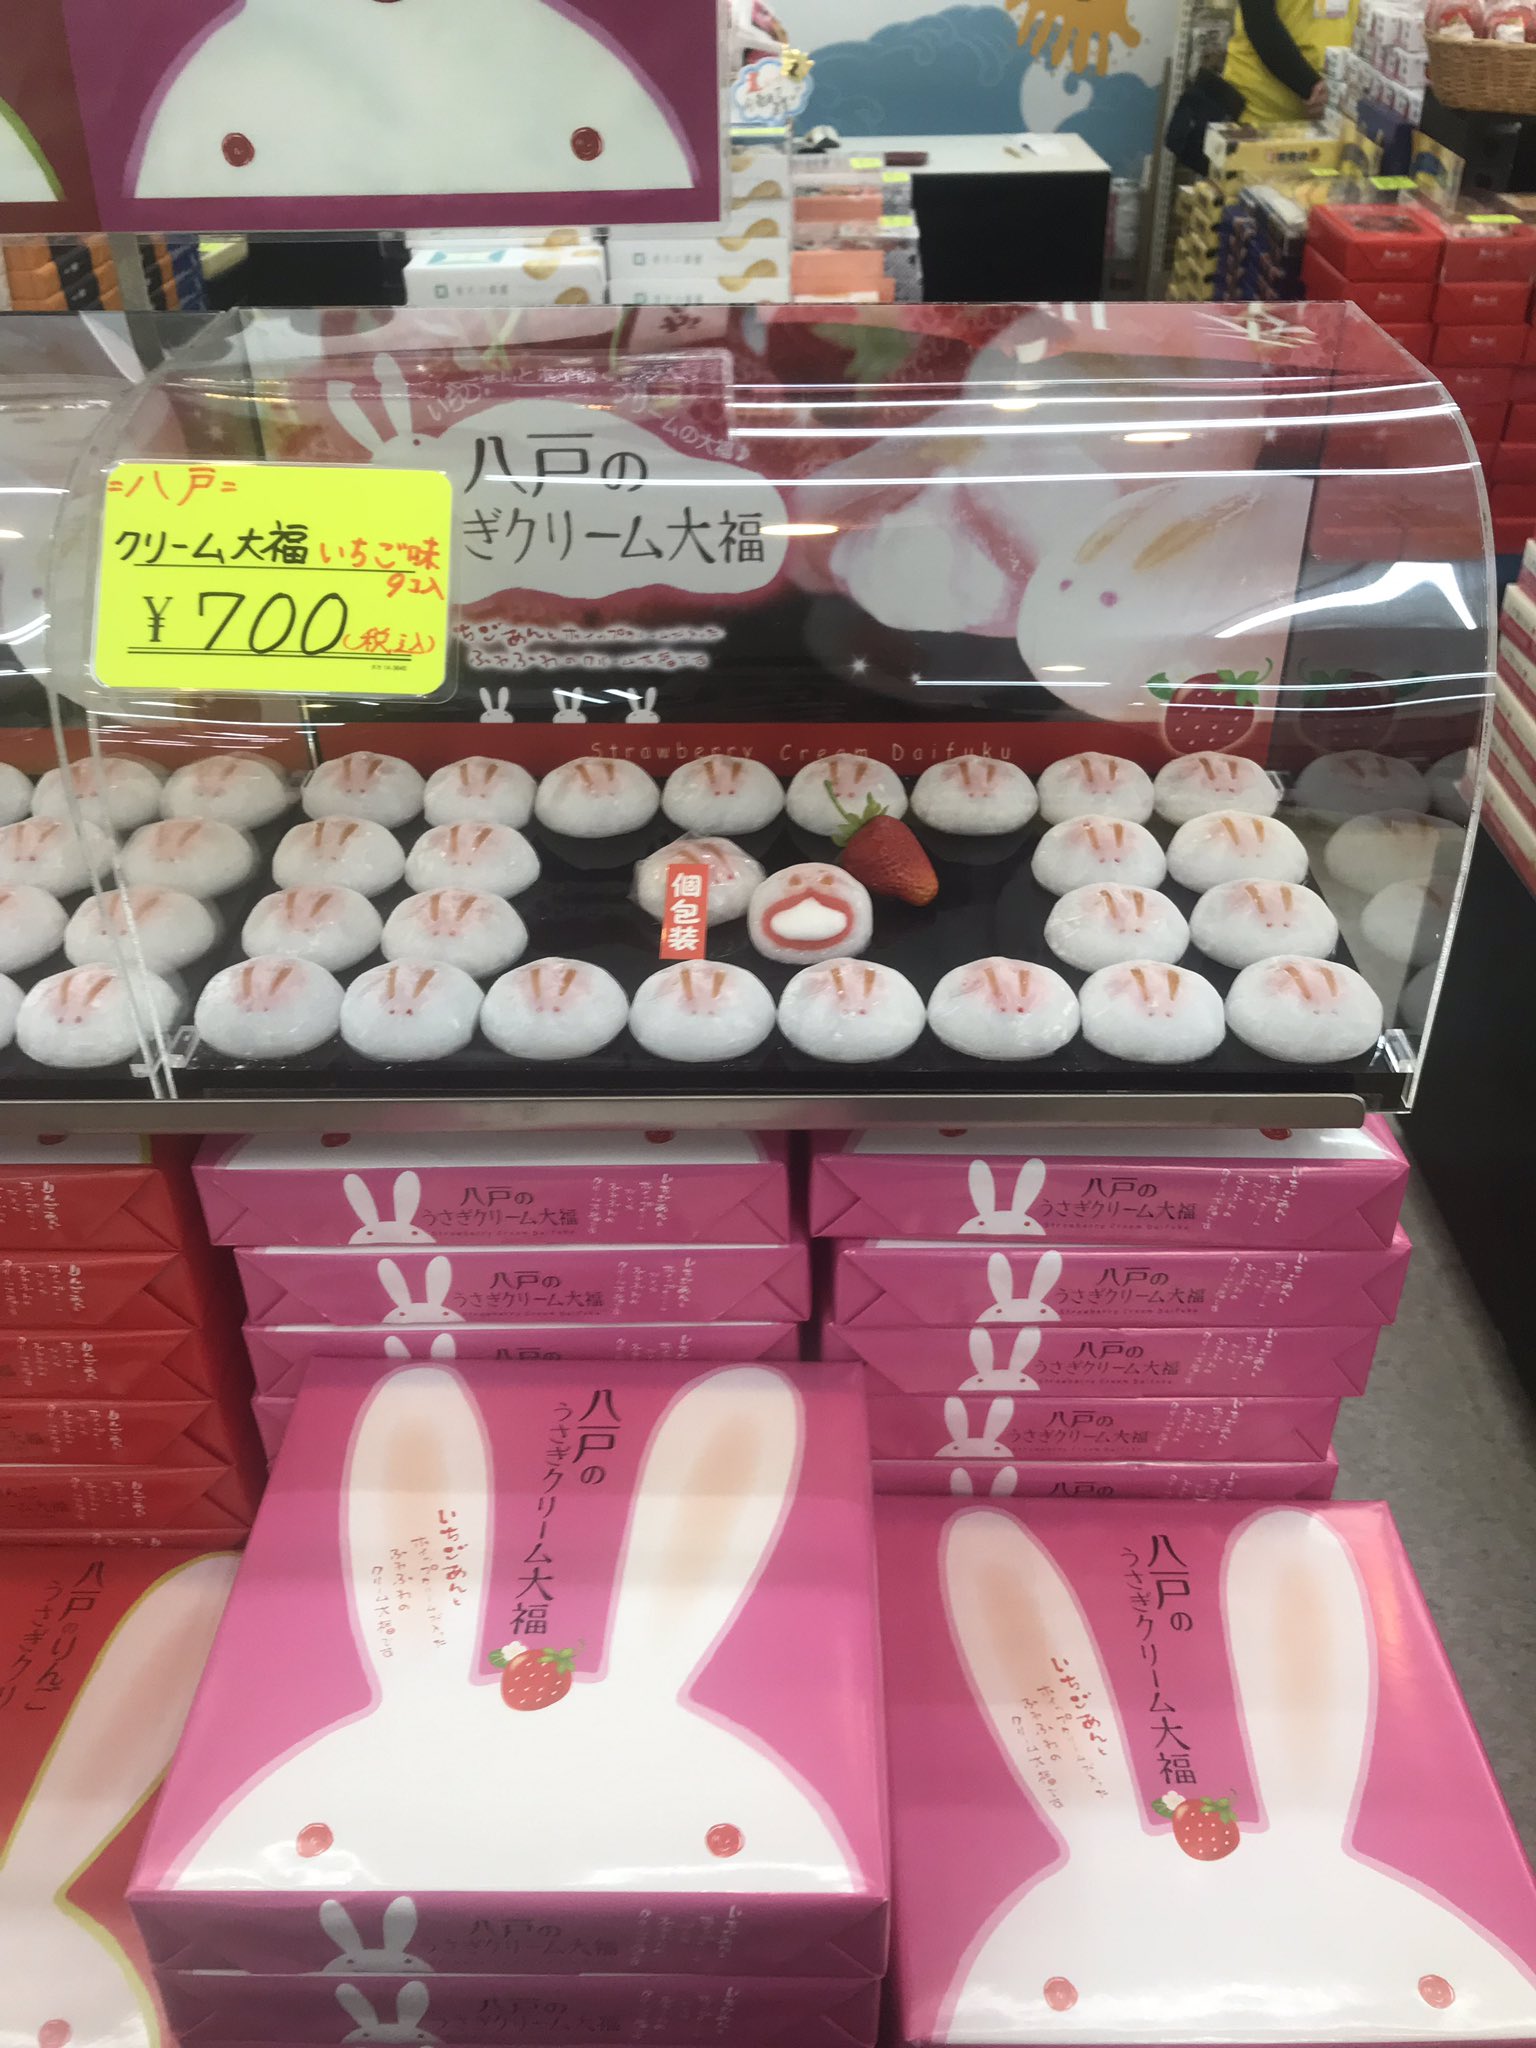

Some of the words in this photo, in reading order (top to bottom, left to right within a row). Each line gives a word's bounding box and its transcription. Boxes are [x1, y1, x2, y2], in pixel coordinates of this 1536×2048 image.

[465, 433, 648, 498] 八戸の
[115, 520, 309, 565] クリーム大福
[319, 537, 441, 571] いちご味
[591, 741, 753, 760] Strawberry
[779, 743, 868, 761] Cream
[891, 741, 1012, 762] Daifuku
[668, 872, 704, 952] 個包装
[460, 1186, 535, 1207] 八戸の
[1081, 1177, 1158, 1198] 八戸の
[422, 1208, 579, 1227] うさぎクリーム大福
[1039, 1200, 1198, 1221] うさぎクリーム大福
[489, 1270, 561, 1290] 八戸の
[1096, 1266, 1169, 1287] 八戸の
[453, 1291, 605, 1308] うさぎクリーム大福
[1055, 1288, 1206, 1305] うさぎクリーム大福
[1075, 1340, 1145, 1360] 八戸の
[1034, 1360, 1182, 1376] うさぎクリーム大福
[1048, 1410, 1115, 1428] 八戸の
[572, 1388, 622, 1485] 八戸の
[510, 1401, 574, 1636] うさぎクリーム大福
[437, 1509, 470, 1606] いちごあんと
[1147, 1533, 1194, 1633] 八戸の
[1120, 1547, 1198, 1785] うさぎクリーム大福
